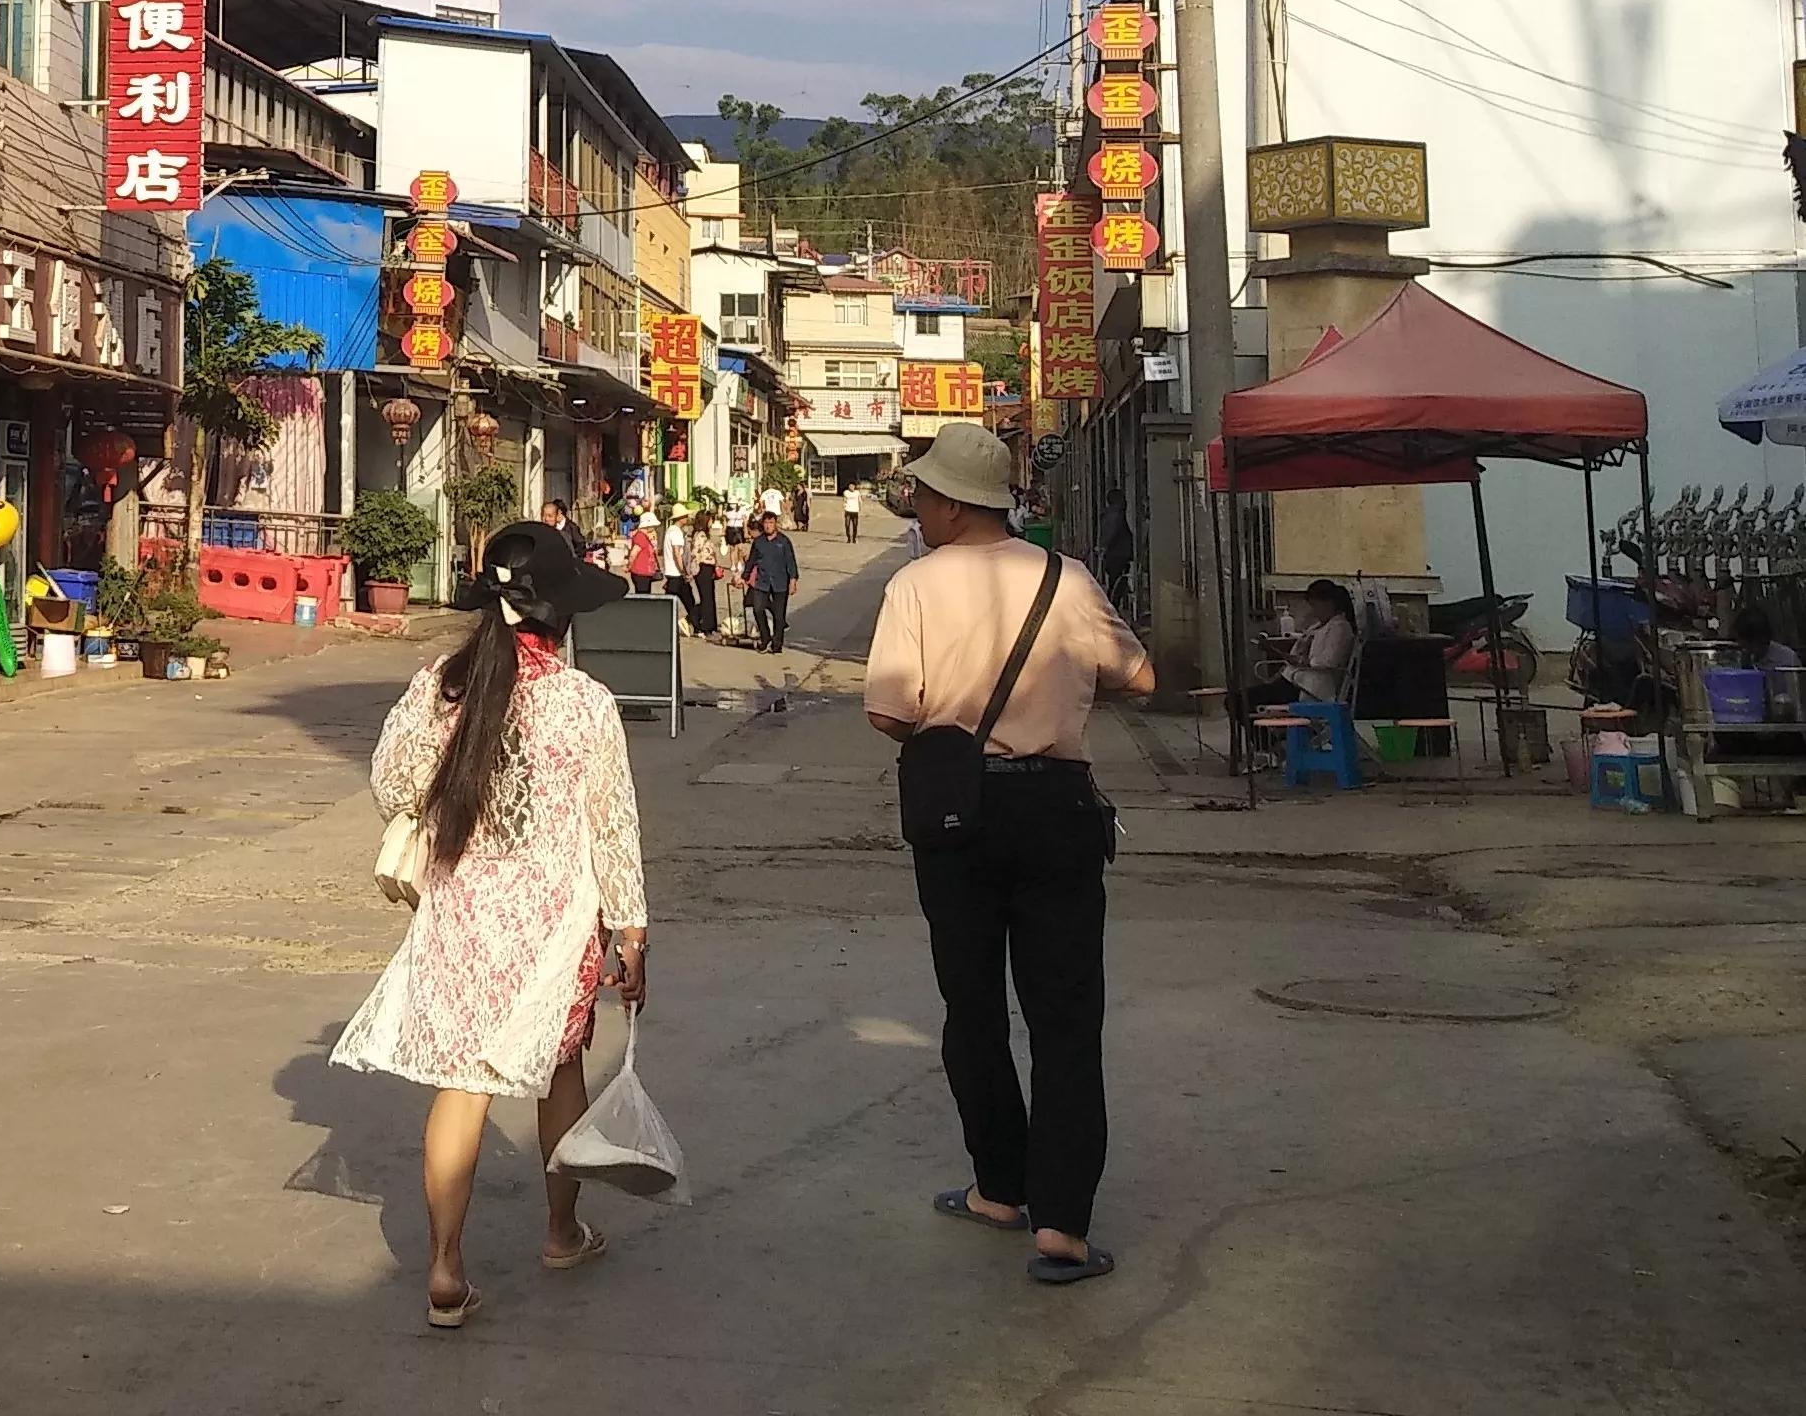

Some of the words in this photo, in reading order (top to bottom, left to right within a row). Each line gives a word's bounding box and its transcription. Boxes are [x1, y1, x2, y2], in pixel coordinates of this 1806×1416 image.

[116, 0, 194, 204] 便利店
[1101, 12, 1143, 253] 歪歪烧烤
[410, 176, 448, 357] 歪歪烧烤
[1043, 199, 1098, 397] 歪歪饭店烧烤
[652, 315, 700, 415] 超市
[902, 363, 983, 410] 超市
